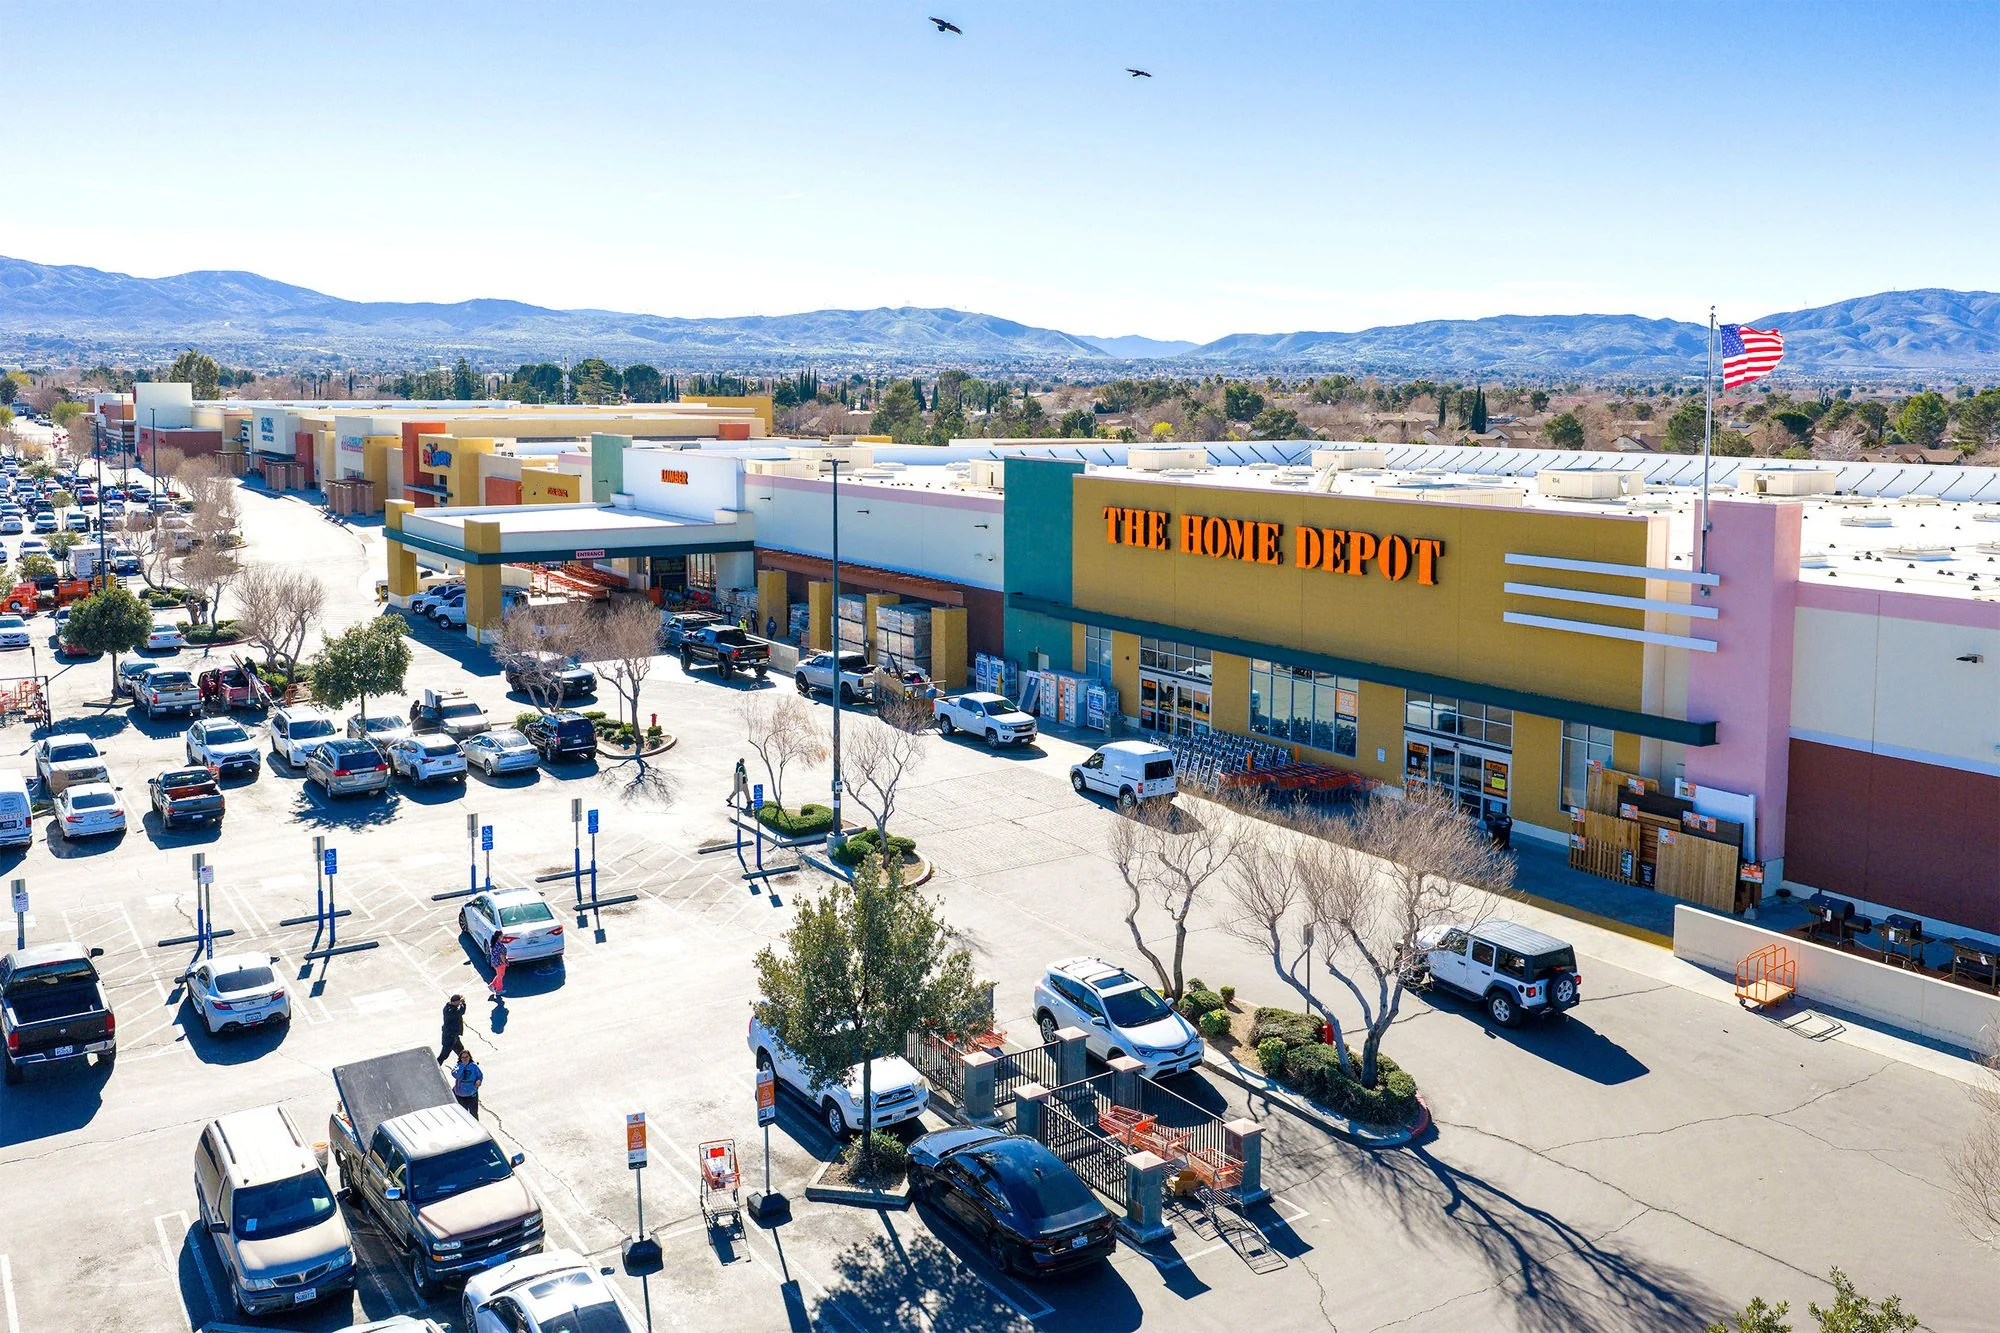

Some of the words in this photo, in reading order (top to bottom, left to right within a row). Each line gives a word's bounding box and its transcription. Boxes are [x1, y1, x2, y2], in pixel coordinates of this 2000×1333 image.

[661, 469, 688, 485] LUMBER
[1103, 506, 1170, 550] THE
[1180, 514, 1283, 565] HOME
[1295, 526, 1445, 585] DEPOT
